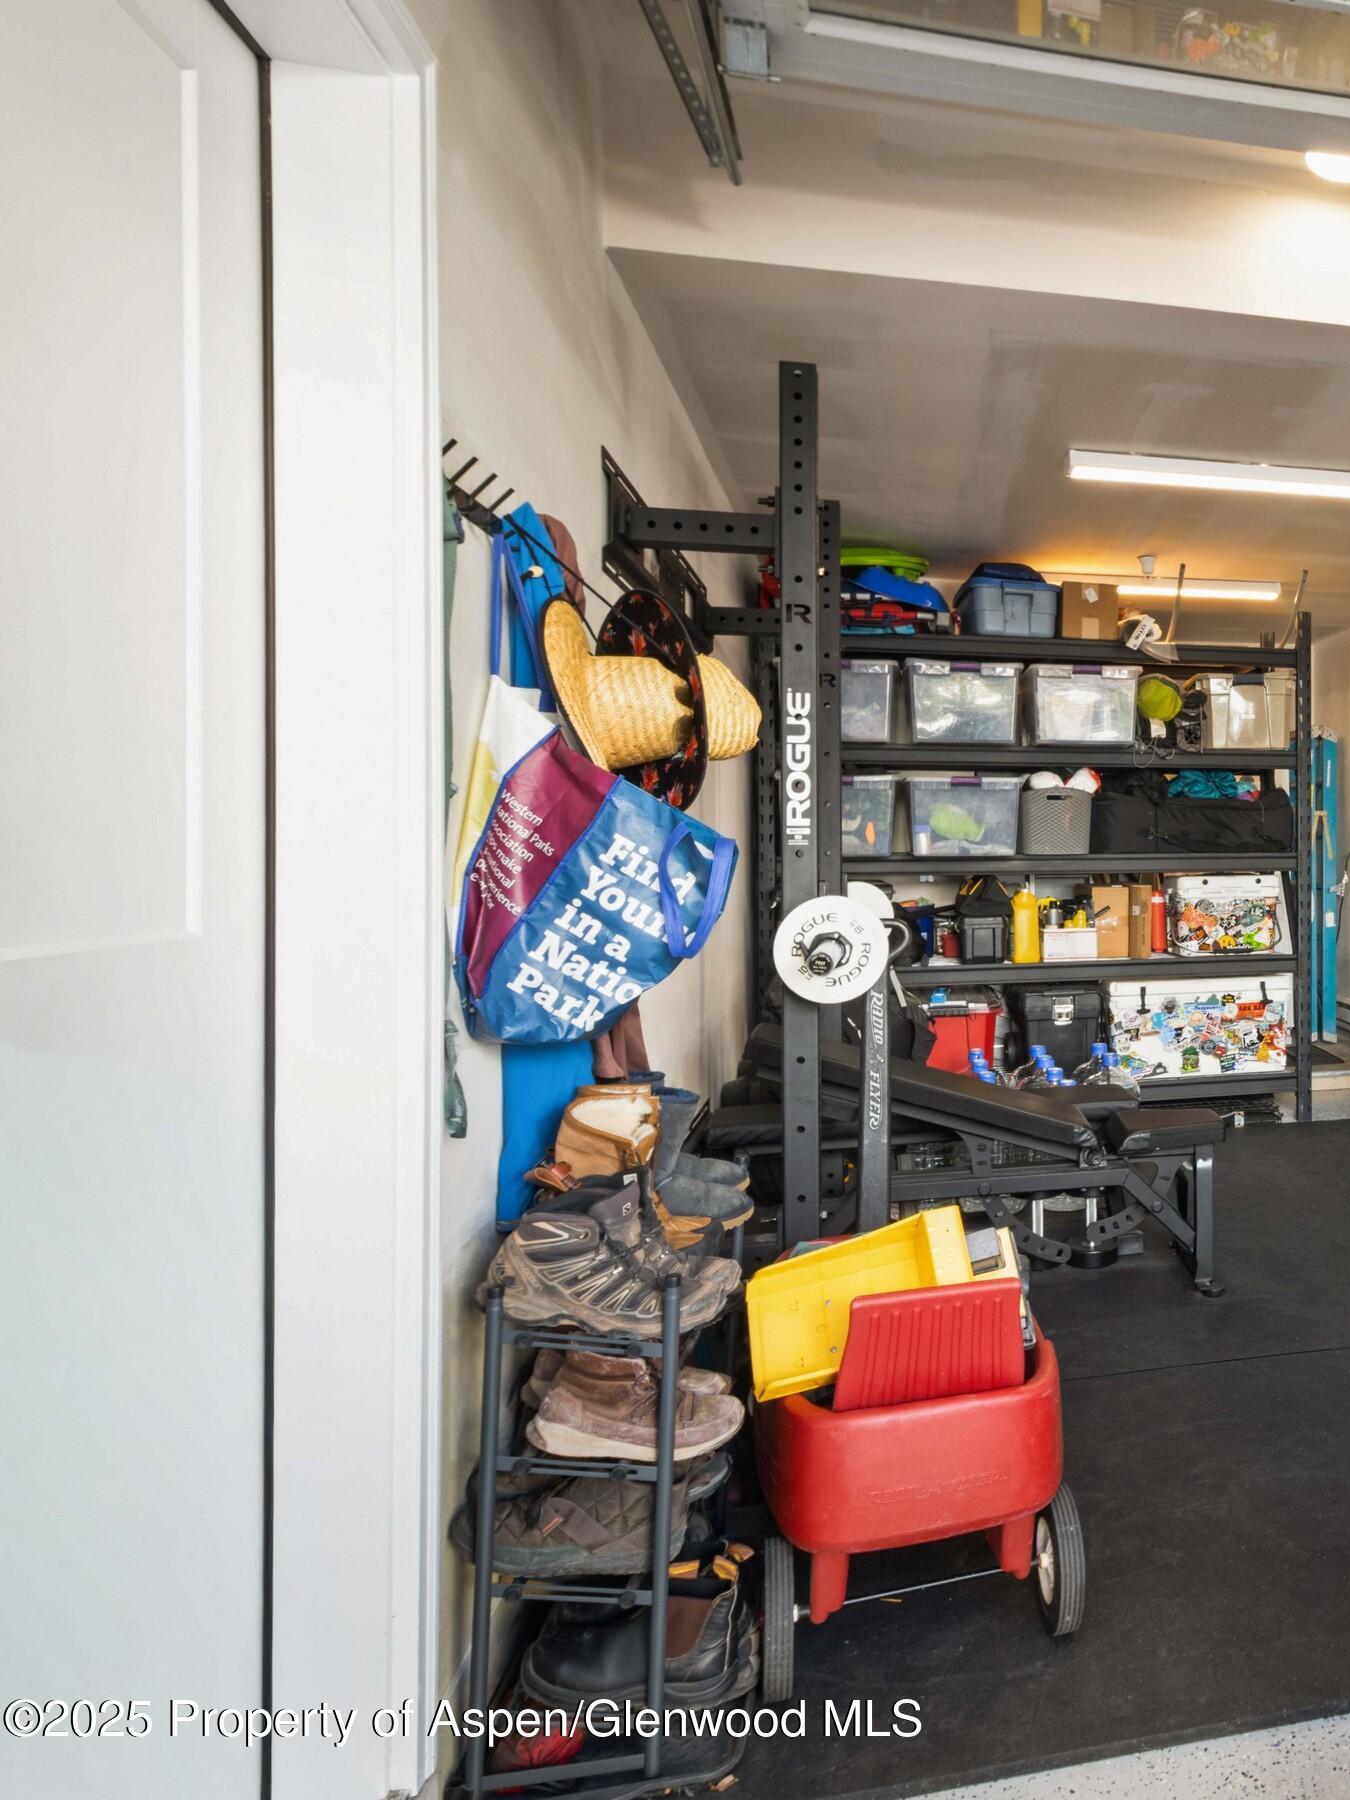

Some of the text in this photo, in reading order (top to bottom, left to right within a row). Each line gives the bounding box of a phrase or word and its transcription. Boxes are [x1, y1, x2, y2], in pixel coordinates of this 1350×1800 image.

[786, 690, 812, 836] ROGUE
[501, 789, 543, 826] Western
[496, 848, 523, 875] make
[530, 833, 554, 857] Parks
[554, 898, 632, 962] in a
[791, 912, 839, 957] ROGUE
[824, 942, 871, 988] ROGUE
[506, 963, 605, 1033] Park
[869, 989, 884, 1048] RADIO
[869, 1070, 883, 1130] FLYER
